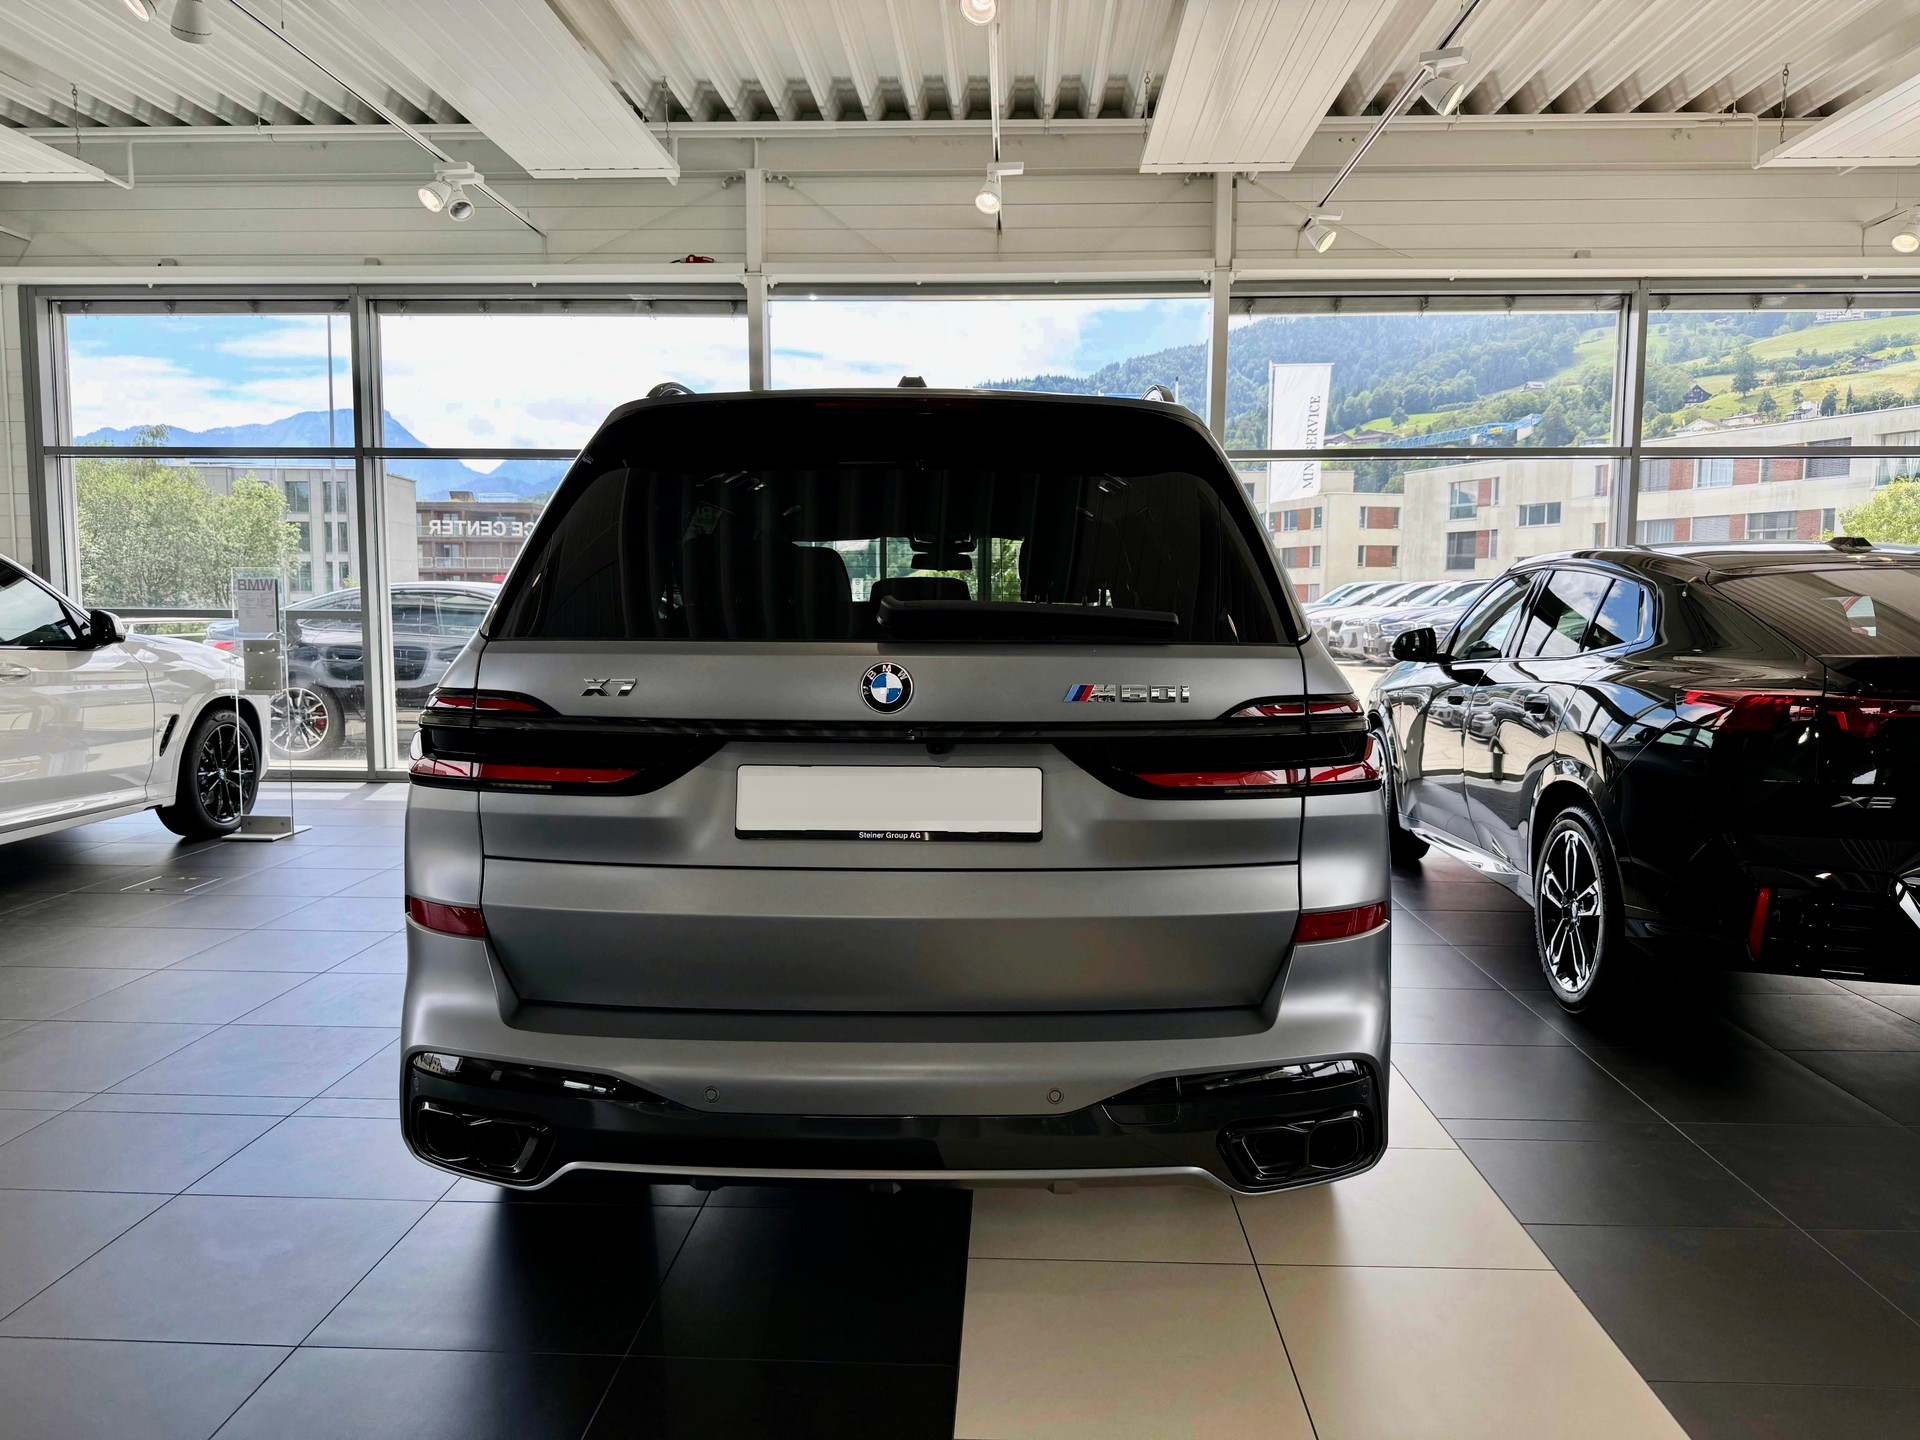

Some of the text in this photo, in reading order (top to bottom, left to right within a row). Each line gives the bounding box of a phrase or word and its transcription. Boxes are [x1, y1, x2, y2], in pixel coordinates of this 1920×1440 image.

[1303, 396, 1321, 489] MIN SERVICE
[238, 579, 273, 591] BMW
[866, 664, 908, 681] BMW
[580, 678, 637, 696] X7
[1831, 795, 1897, 808] X2
[858, 831, 921, 840] Steiner Group AG
